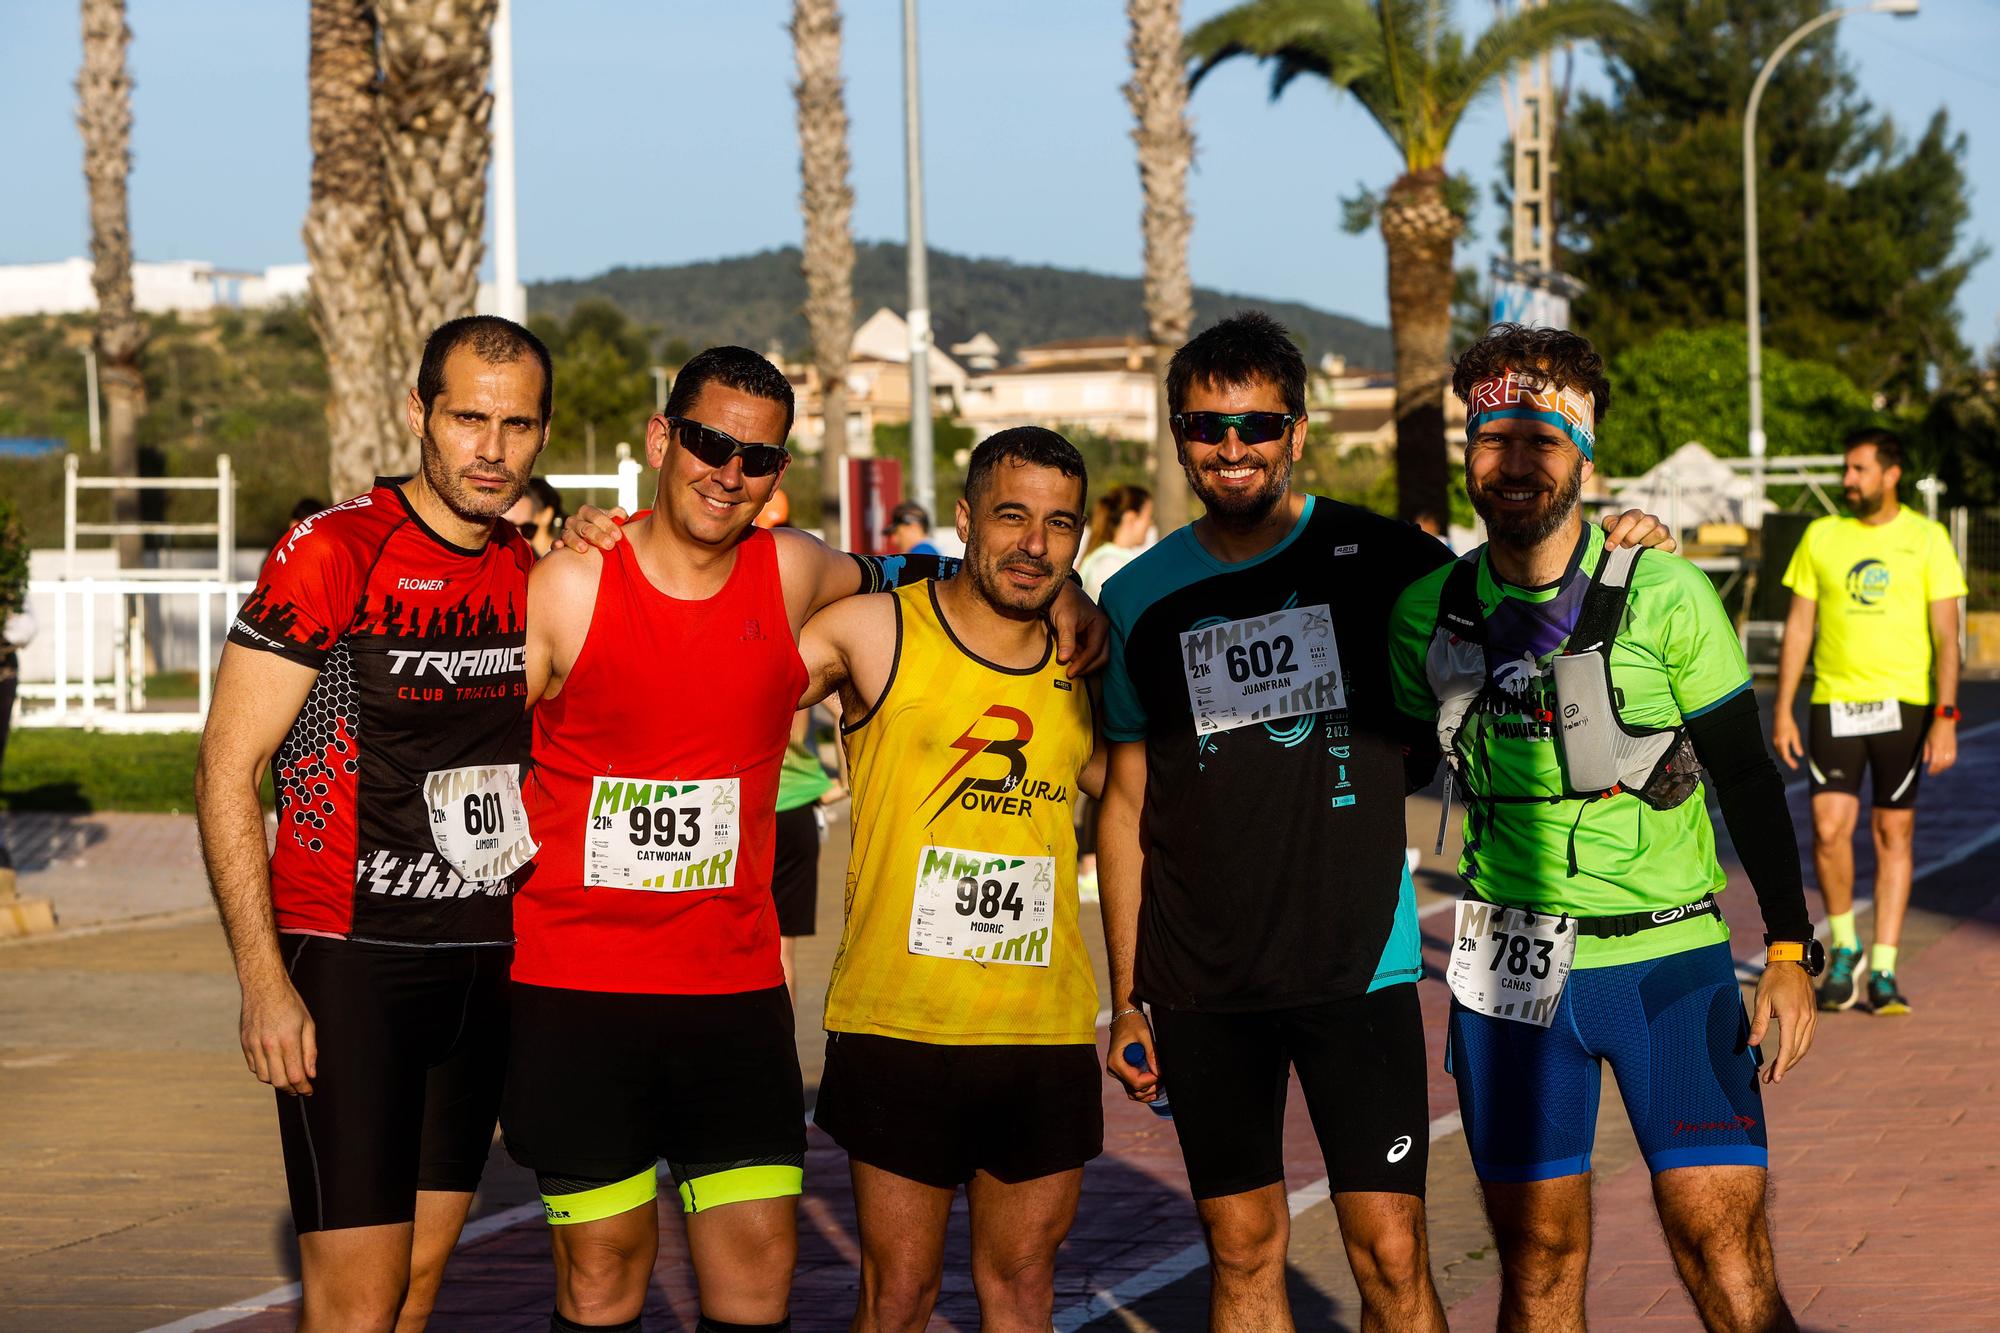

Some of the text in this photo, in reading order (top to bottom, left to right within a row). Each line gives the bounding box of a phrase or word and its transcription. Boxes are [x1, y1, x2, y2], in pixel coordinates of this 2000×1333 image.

[397, 578, 444, 591] FLOWER
[387, 645, 526, 685] TRIAMIC
[1225, 634, 1299, 683] 602
[1191, 663, 1211, 679] 21k
[398, 686, 444, 701] CLUB
[1241, 676, 1291, 696] JUANFRAN
[1326, 725, 1349, 738] 2022
[1564, 715, 1590, 733] Kalenji
[432, 808, 447, 824] 21k
[463, 791, 505, 836] 601
[593, 815, 613, 831] 21k
[628, 805, 702, 848] 993
[475, 838, 499, 850] LIMORTI
[637, 850, 692, 862] CATWOMAN
[955, 876, 1025, 921] 984
[970, 921, 1004, 935] MODRIC
[1459, 936, 1477, 952] 21k
[1489, 930, 1555, 980] 783
[1501, 977, 1532, 992] CAÑAS
